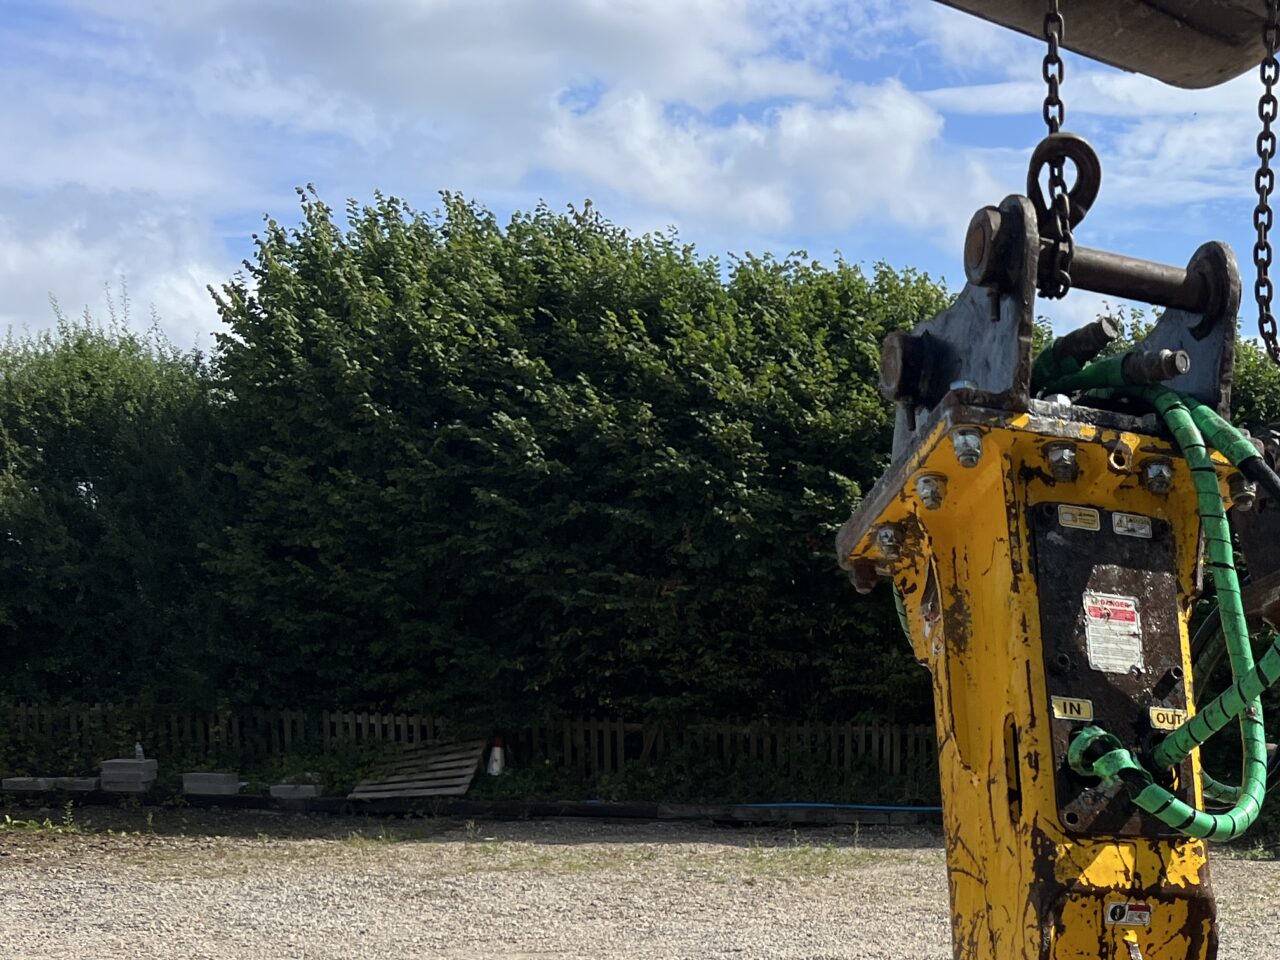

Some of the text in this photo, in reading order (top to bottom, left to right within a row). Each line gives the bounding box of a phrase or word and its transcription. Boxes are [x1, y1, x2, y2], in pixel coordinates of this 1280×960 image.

[1100, 599, 1132, 608] DANGER
[1062, 701, 1081, 715] IN
[1157, 713, 1182, 725] OUT
